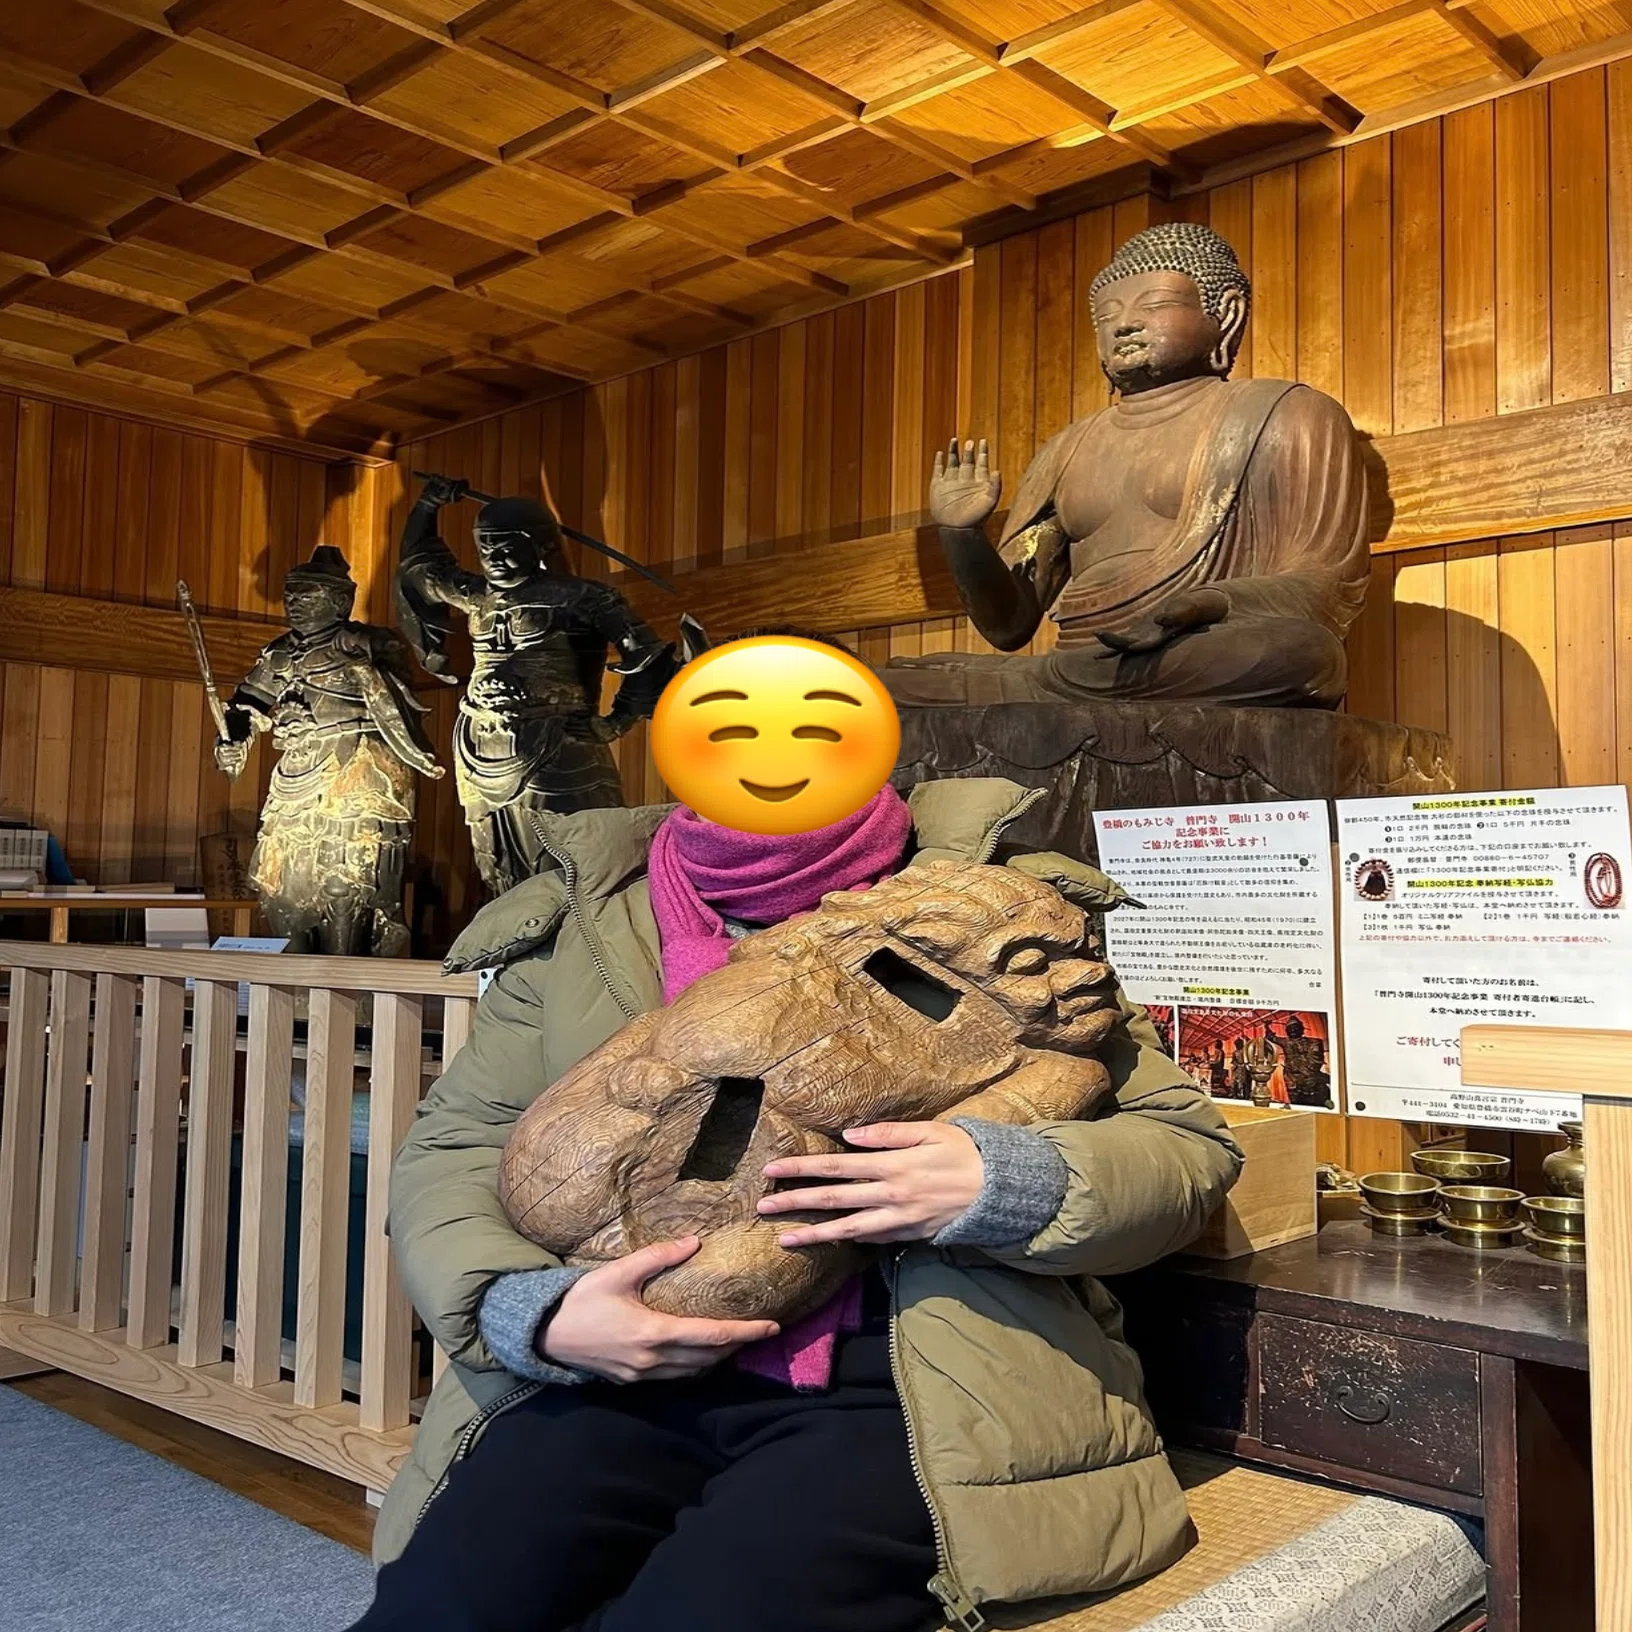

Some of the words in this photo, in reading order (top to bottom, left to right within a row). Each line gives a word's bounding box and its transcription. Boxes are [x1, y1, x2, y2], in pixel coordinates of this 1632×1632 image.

[1413, 798, 1496, 811] 開山1300年記念事業
[1499, 796, 1535, 806] 寄付金額
[1103, 816, 1174, 830] 豊橋のもみじ寺
[1186, 814, 1217, 826] 普門寺
[1176, 826, 1230, 838] 記念事業に
[1143, 836, 1266, 851] ご協力をお願い致します！
[1407, 879, 1473, 889] 開山1300年記念
[1396, 1036, 1460, 1048] ご寄付してく
